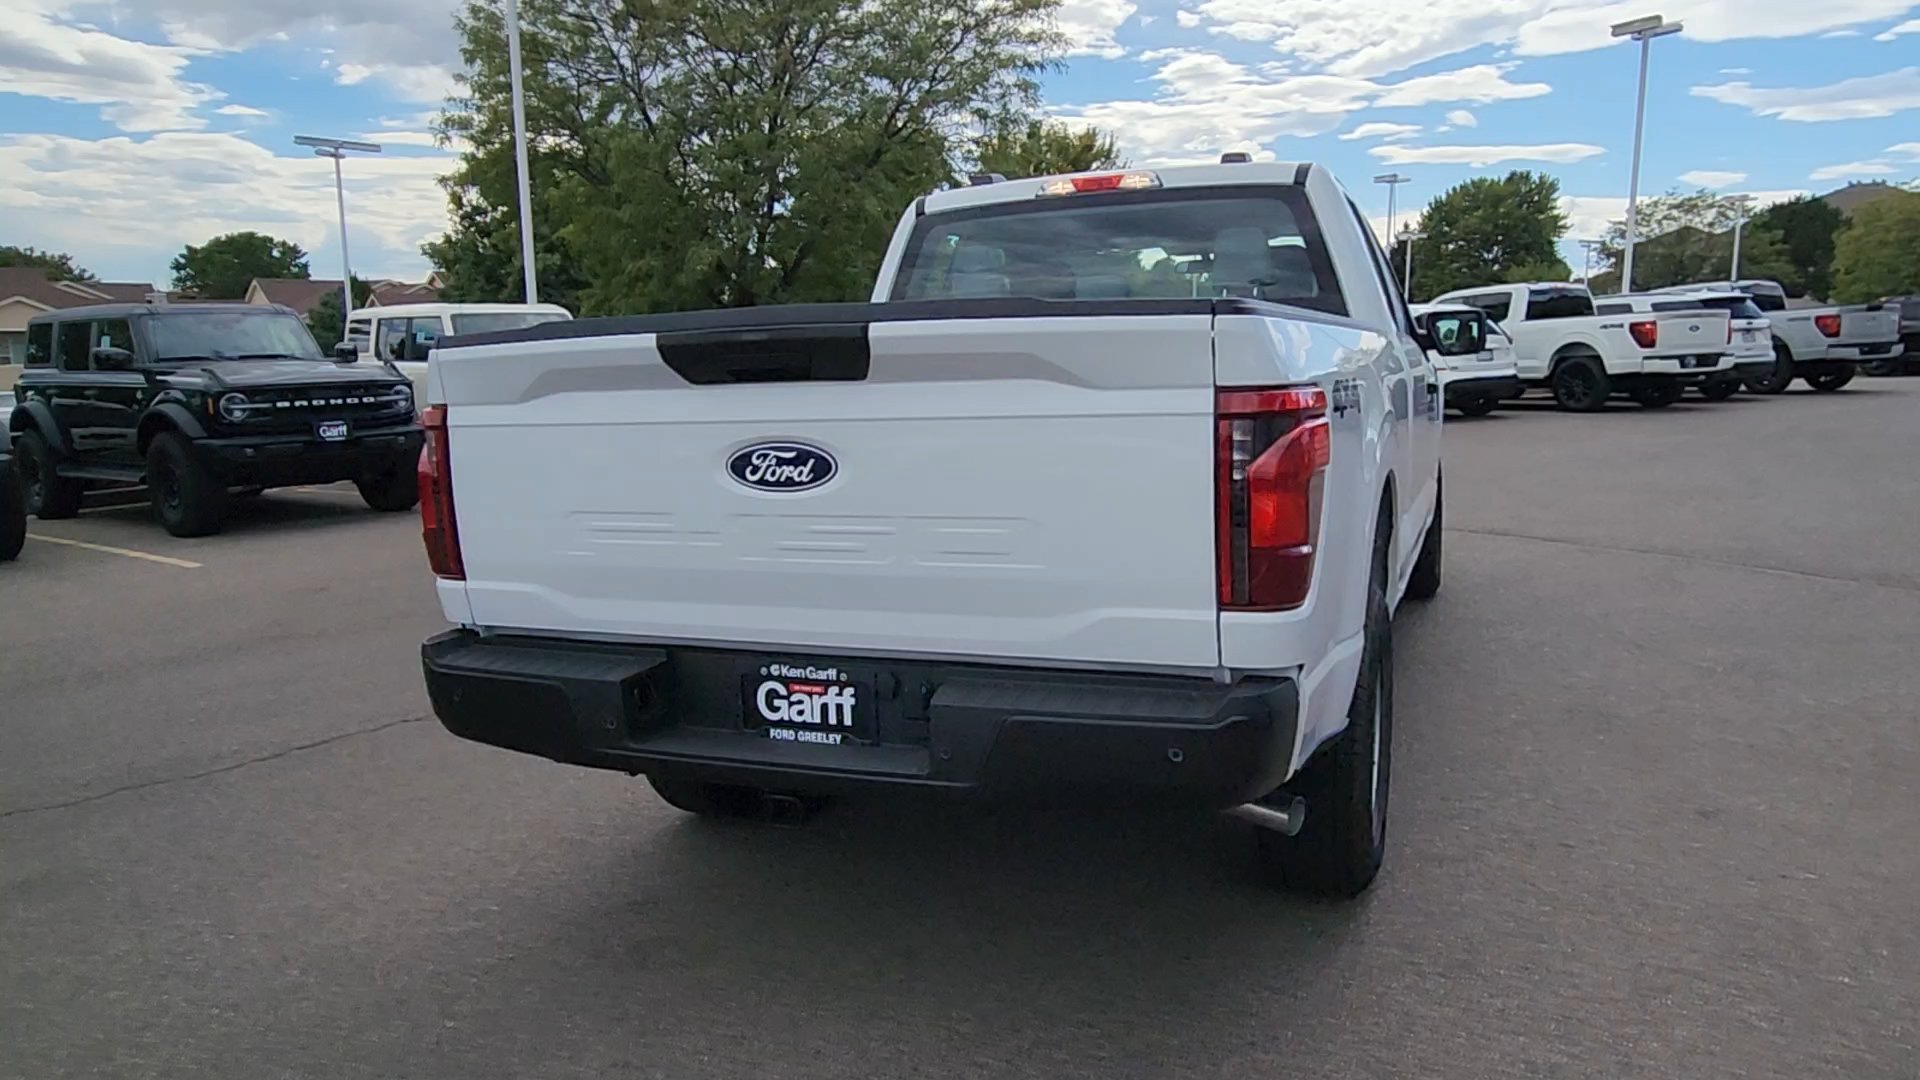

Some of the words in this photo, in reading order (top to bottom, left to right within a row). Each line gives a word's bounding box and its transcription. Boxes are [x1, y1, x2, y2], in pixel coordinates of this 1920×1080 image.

[745, 449, 815, 482] Ford
[781, 664, 805, 678] Ken
[806, 666, 837, 681] Garff
[756, 680, 856, 727] Garff
[769, 727, 795, 740] FORD
[797, 730, 842, 745] GREELEY
